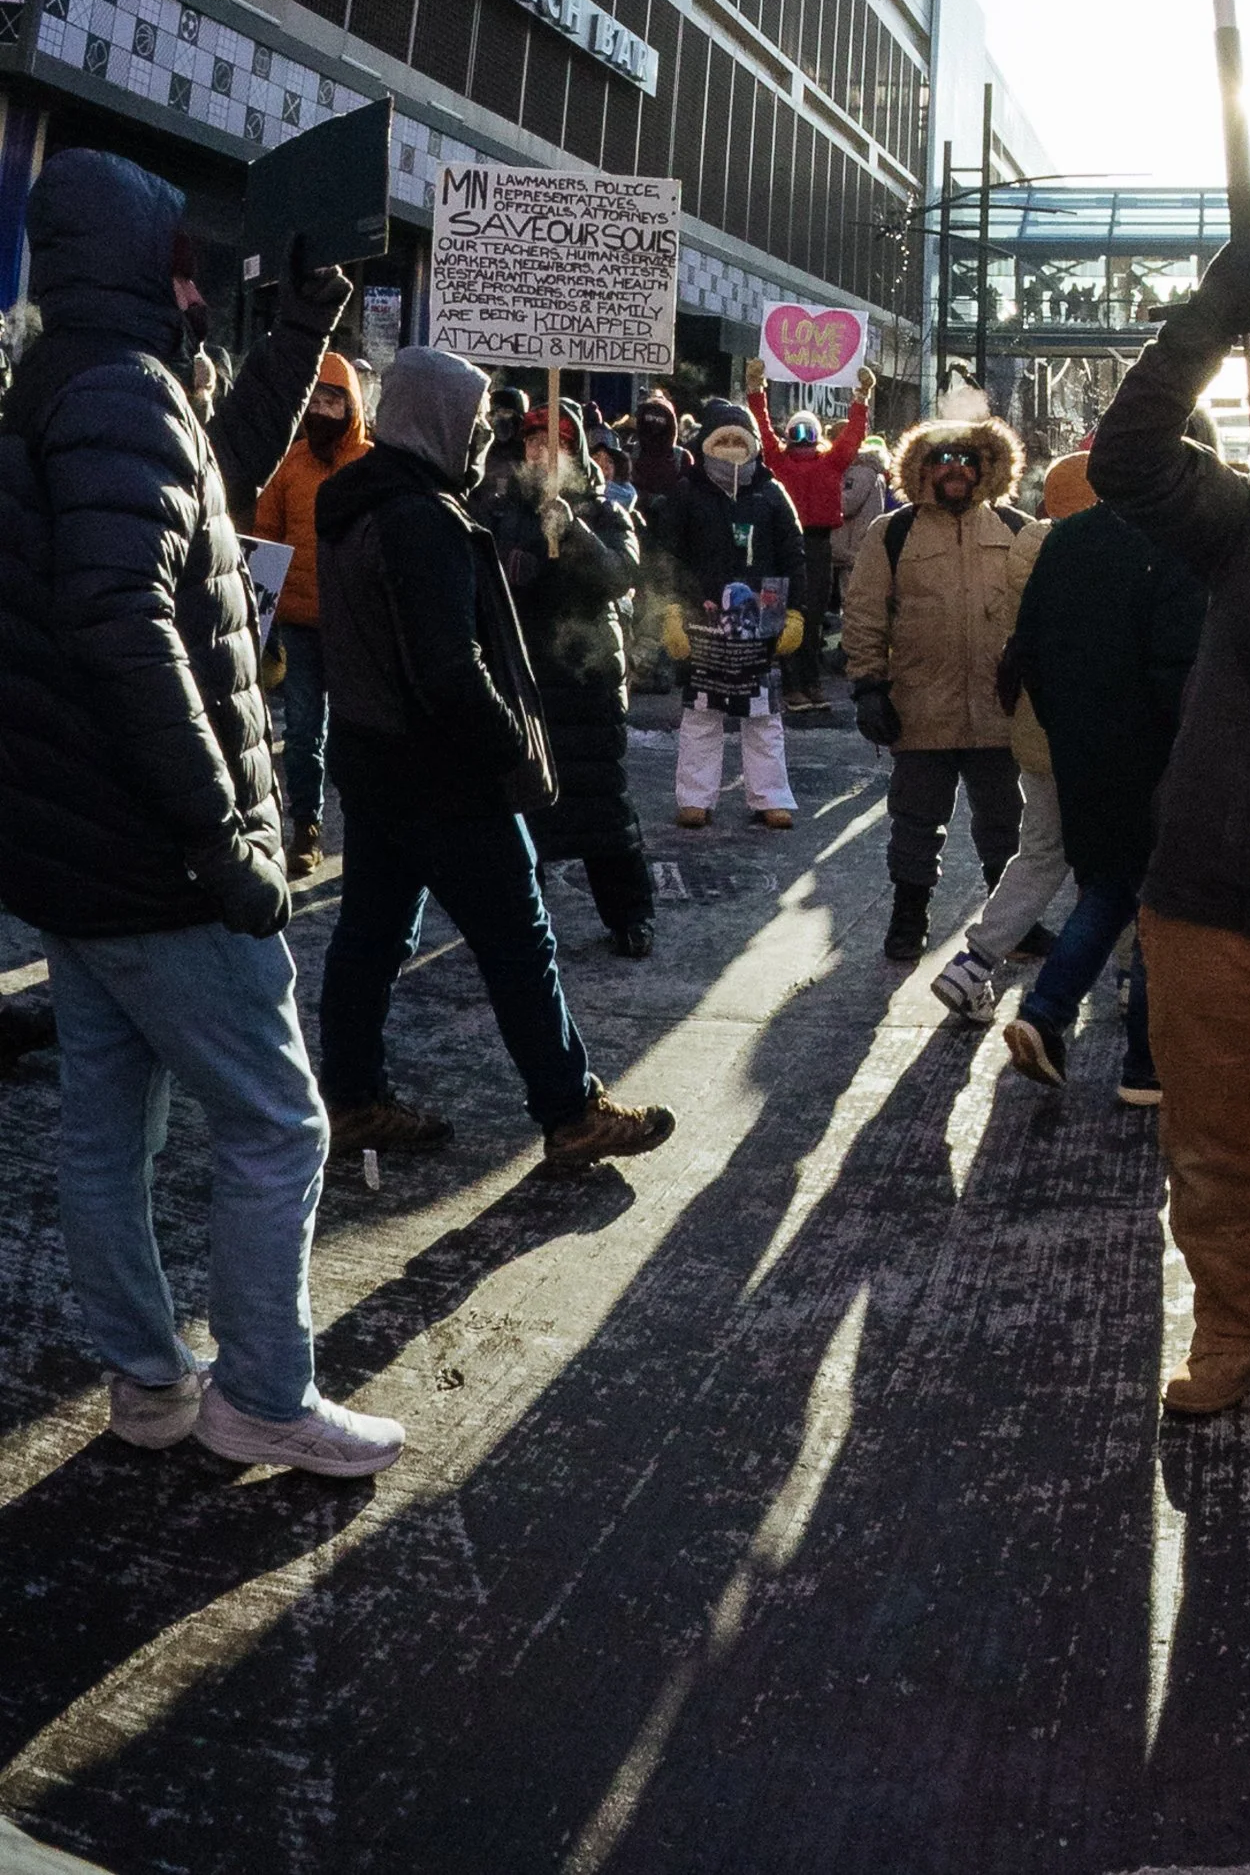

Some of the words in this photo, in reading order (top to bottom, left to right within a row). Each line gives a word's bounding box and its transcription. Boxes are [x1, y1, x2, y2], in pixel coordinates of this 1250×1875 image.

[593, 13, 650, 80] BAR
[442, 167, 489, 210] MN
[438, 236, 478, 253] OUR
[448, 210, 549, 242] SAVE
[547, 219, 600, 248] OUR
[601, 223, 678, 256] SOULS
[434, 267, 533, 283] RESTAURANT
[613, 276, 668, 292] HEALTH
[435, 279, 478, 292] CARE
[568, 287, 652, 305] COMMUNITY
[436, 308, 473, 321] ARE
[479, 308, 528, 323] BEING
[512, 295, 578, 312] FRIENDS
[580, 299, 592, 314] &
[597, 301, 664, 321] FAMILY
[781, 318, 846, 347] LOVE
[550, 337, 565, 356] &
[569, 337, 672, 365] MURDERED
